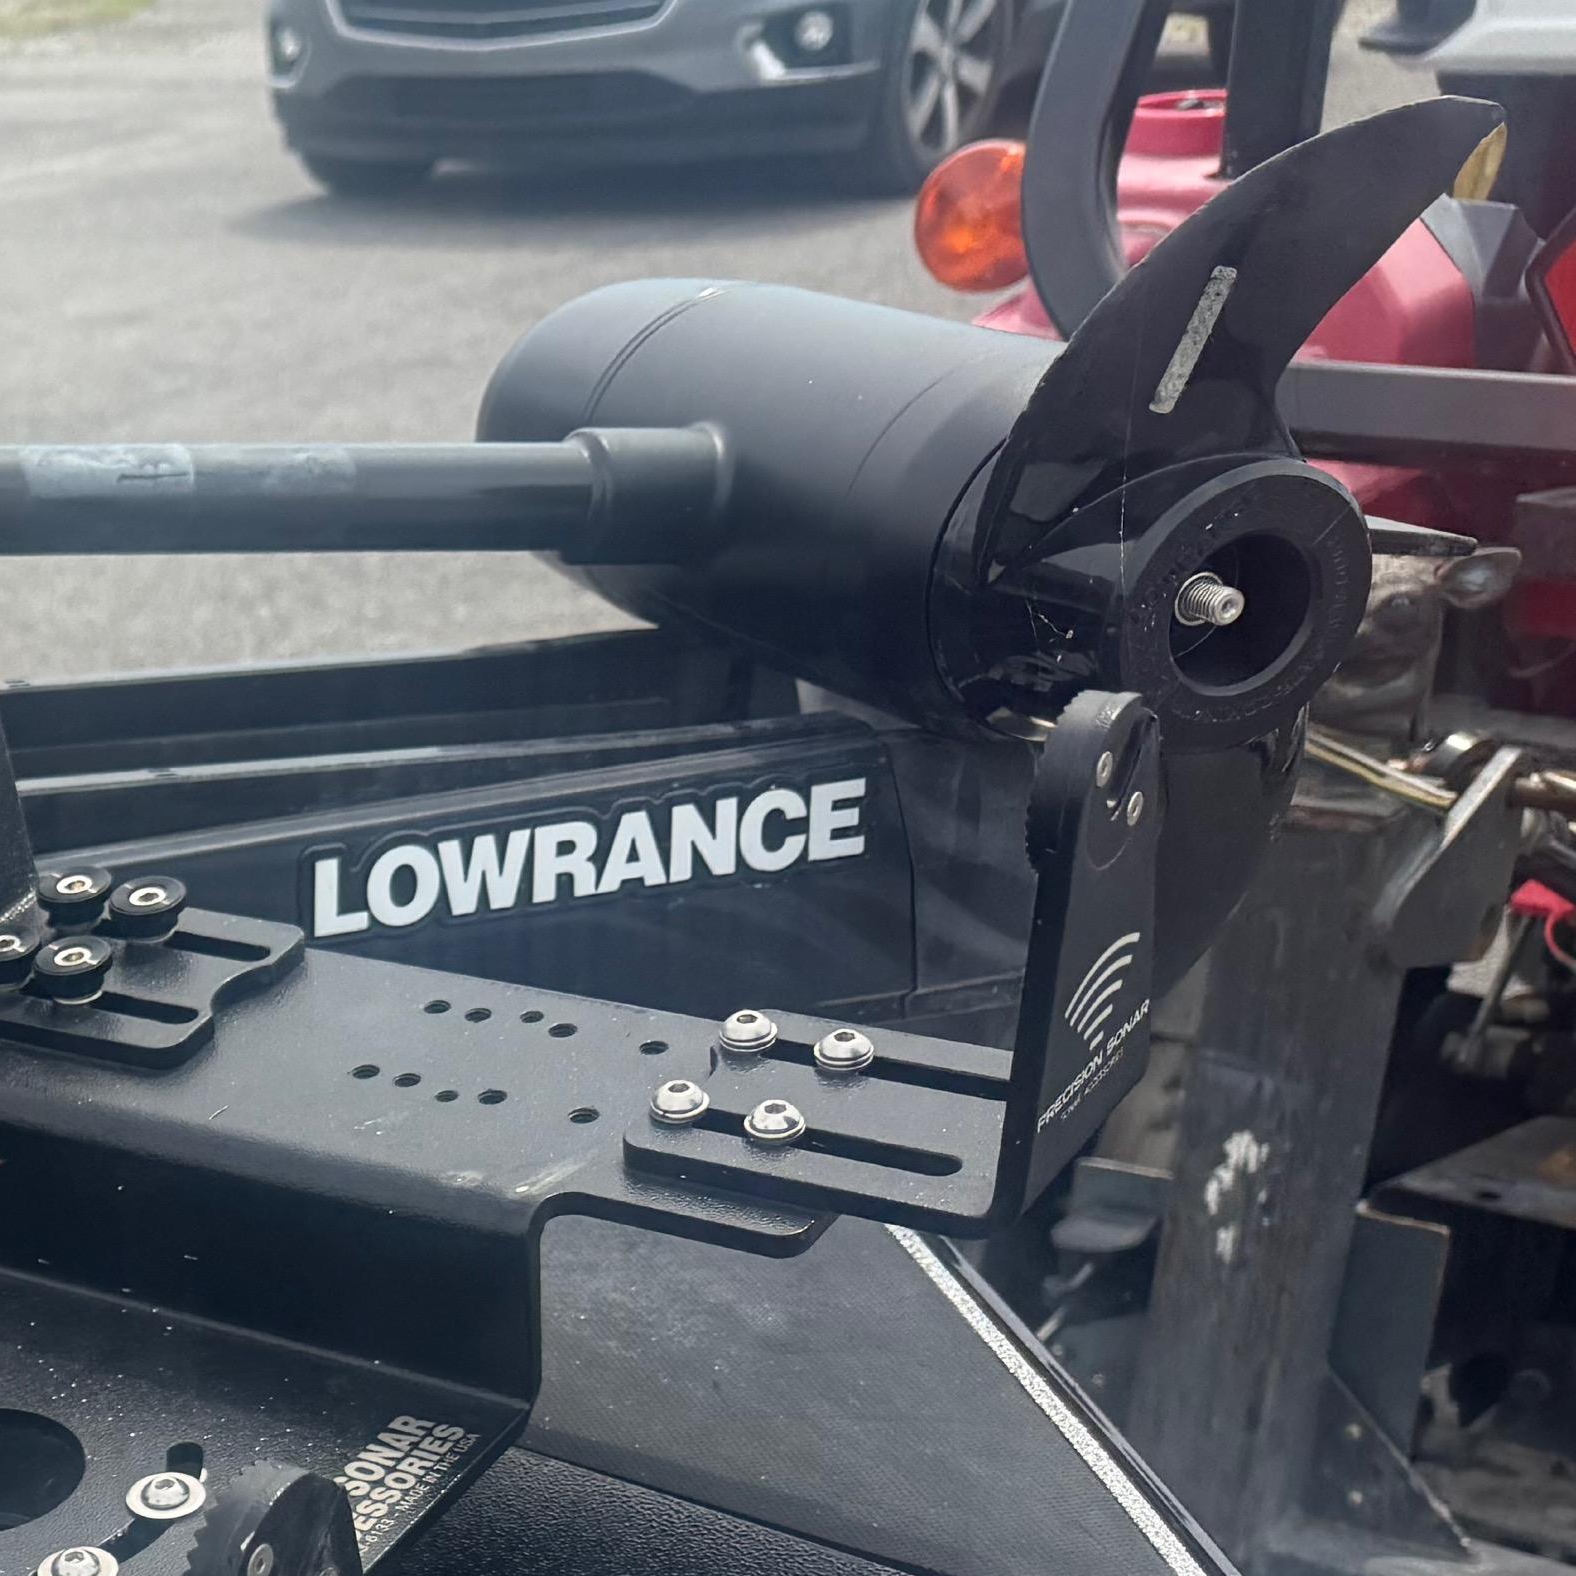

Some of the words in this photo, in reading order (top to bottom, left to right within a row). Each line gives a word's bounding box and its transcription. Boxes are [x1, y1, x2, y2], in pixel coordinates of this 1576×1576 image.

[313, 778, 867, 938] LOWRANCE
[1106, 999, 1149, 1056] SONAR
[354, 1424, 464, 1534] ESSORIES
